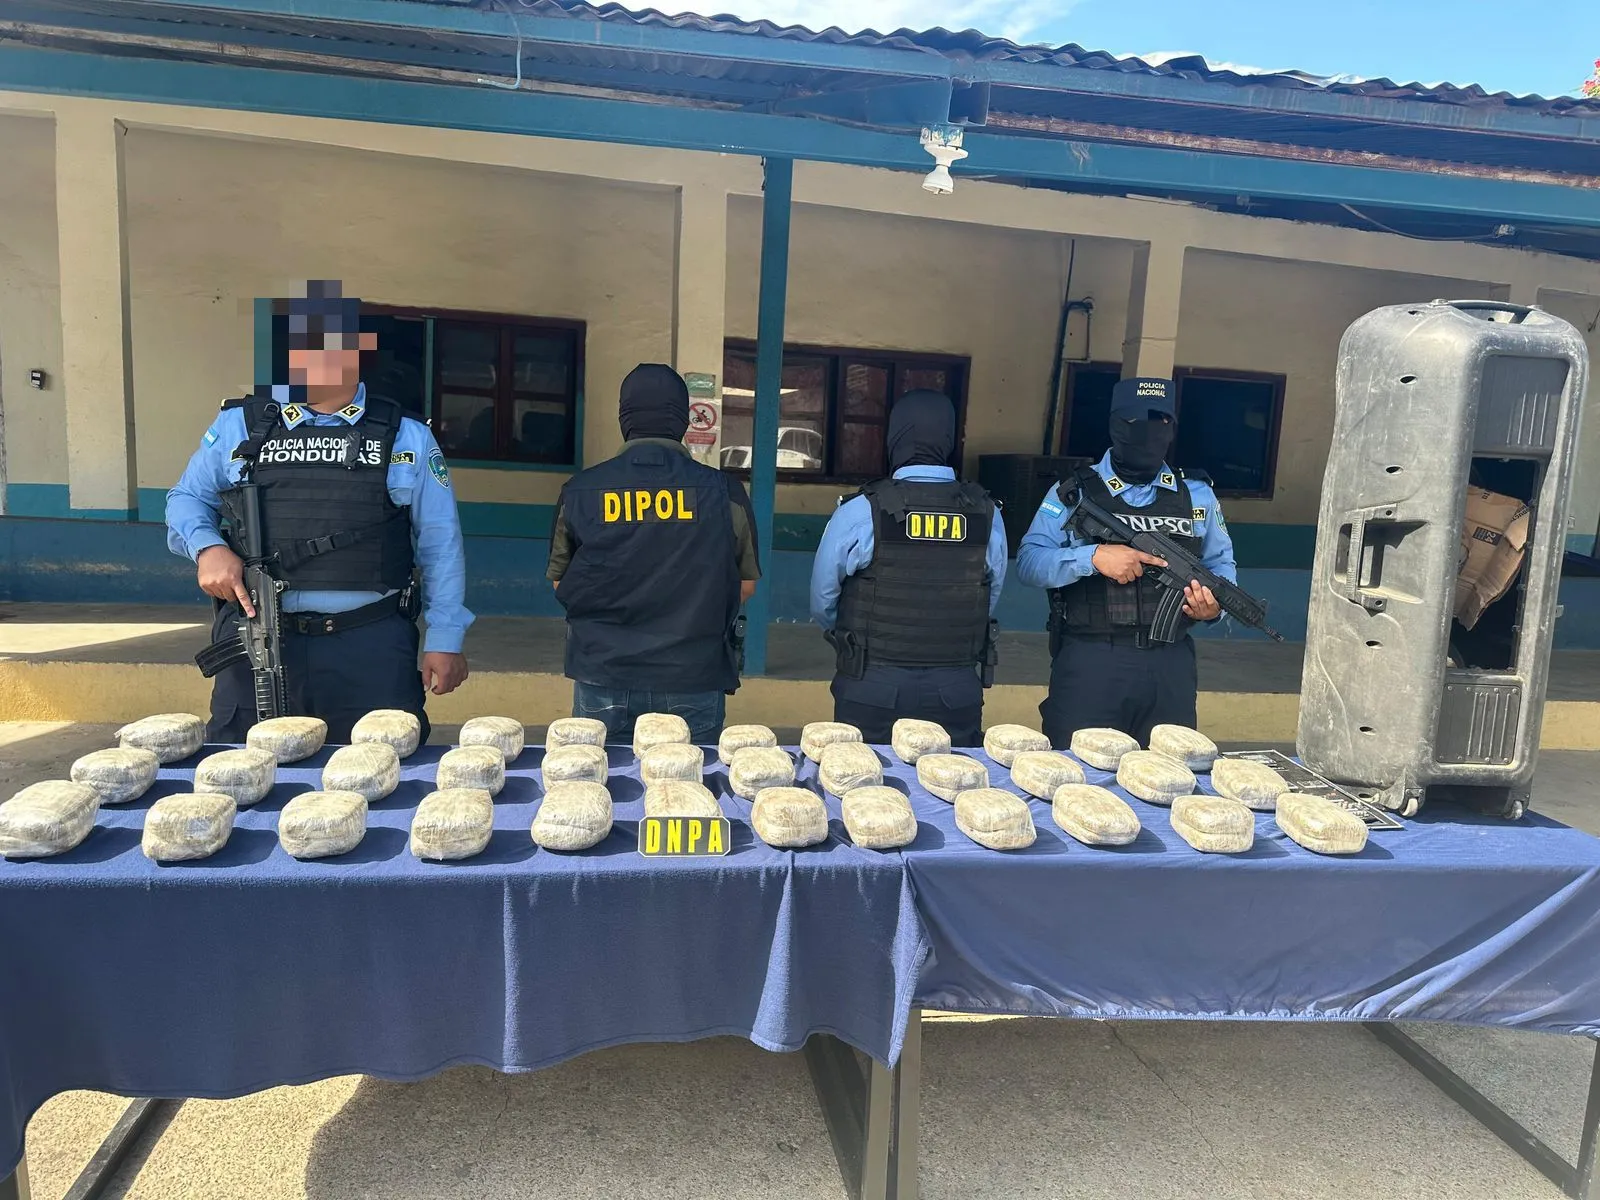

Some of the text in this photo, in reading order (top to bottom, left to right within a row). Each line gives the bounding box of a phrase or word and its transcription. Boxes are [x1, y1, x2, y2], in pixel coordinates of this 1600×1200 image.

[1136, 389, 1166, 398] NACIONAL
[260, 437, 381, 452] POLICIA NACIO DE
[604, 489, 693, 522] DIPOL
[911, 513, 962, 539] DNPA
[645, 819, 723, 853] DNPA
